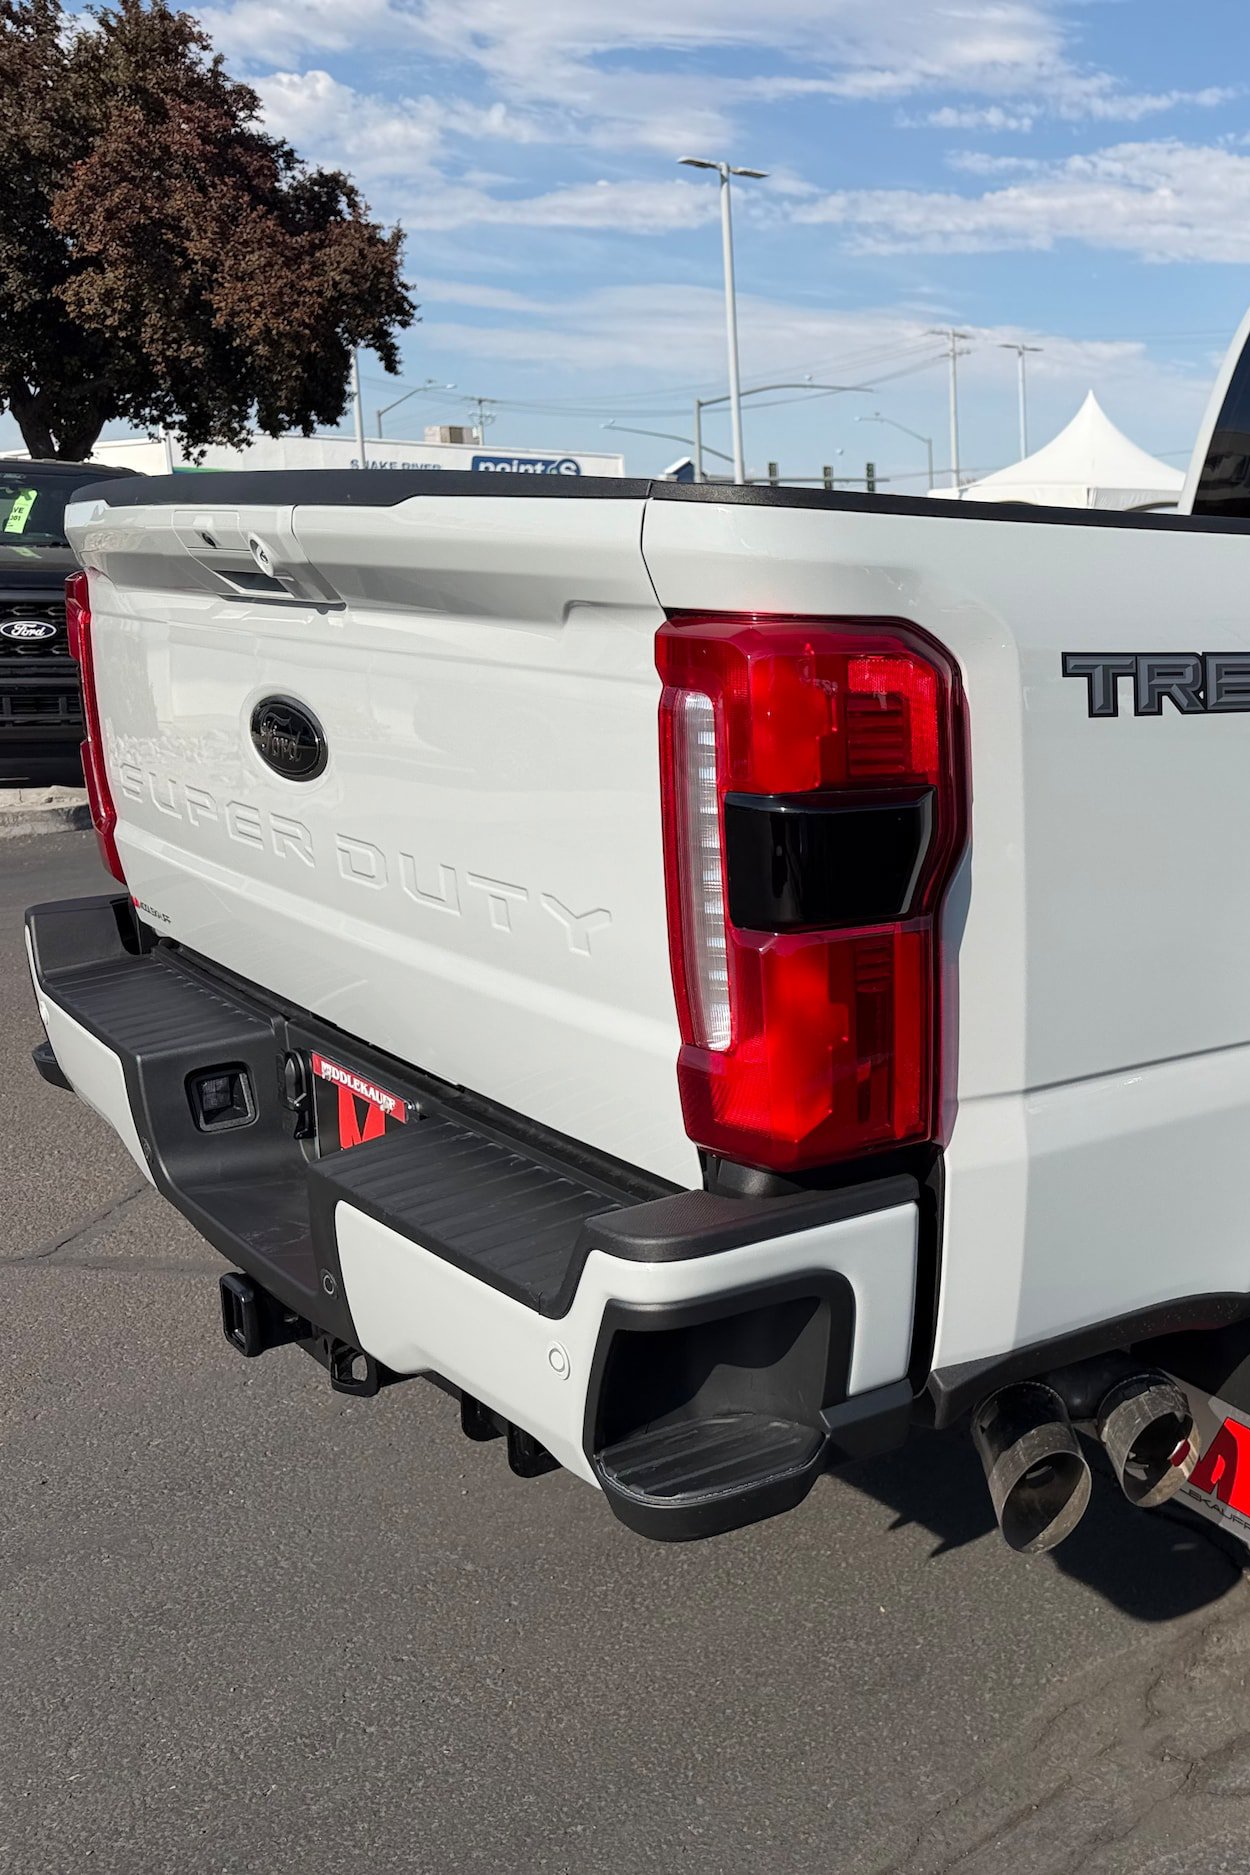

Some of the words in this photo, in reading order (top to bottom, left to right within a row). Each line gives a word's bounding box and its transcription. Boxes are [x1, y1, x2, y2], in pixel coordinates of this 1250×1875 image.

[11, 623, 47, 637] Ford
[260, 706, 303, 762] Ford
[119, 762, 315, 868] SUPER
[336, 832, 613, 957] DUTY
